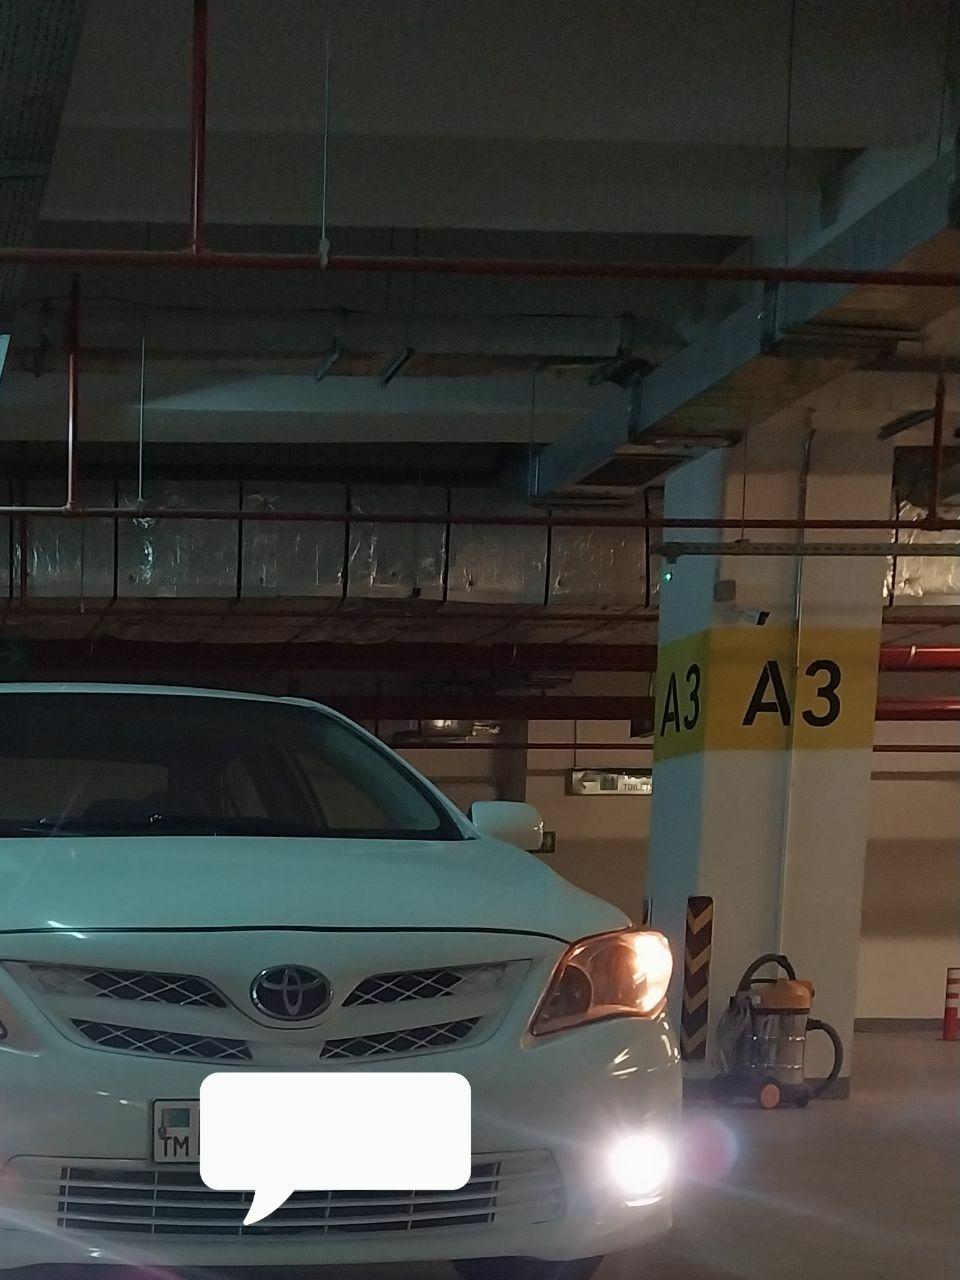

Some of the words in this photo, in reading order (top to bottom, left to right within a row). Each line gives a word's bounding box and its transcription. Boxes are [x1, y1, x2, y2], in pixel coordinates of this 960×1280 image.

[660, 664, 701, 736] A3
[741, 660, 842, 727] A3
[159, 1135, 190, 1158] TM
